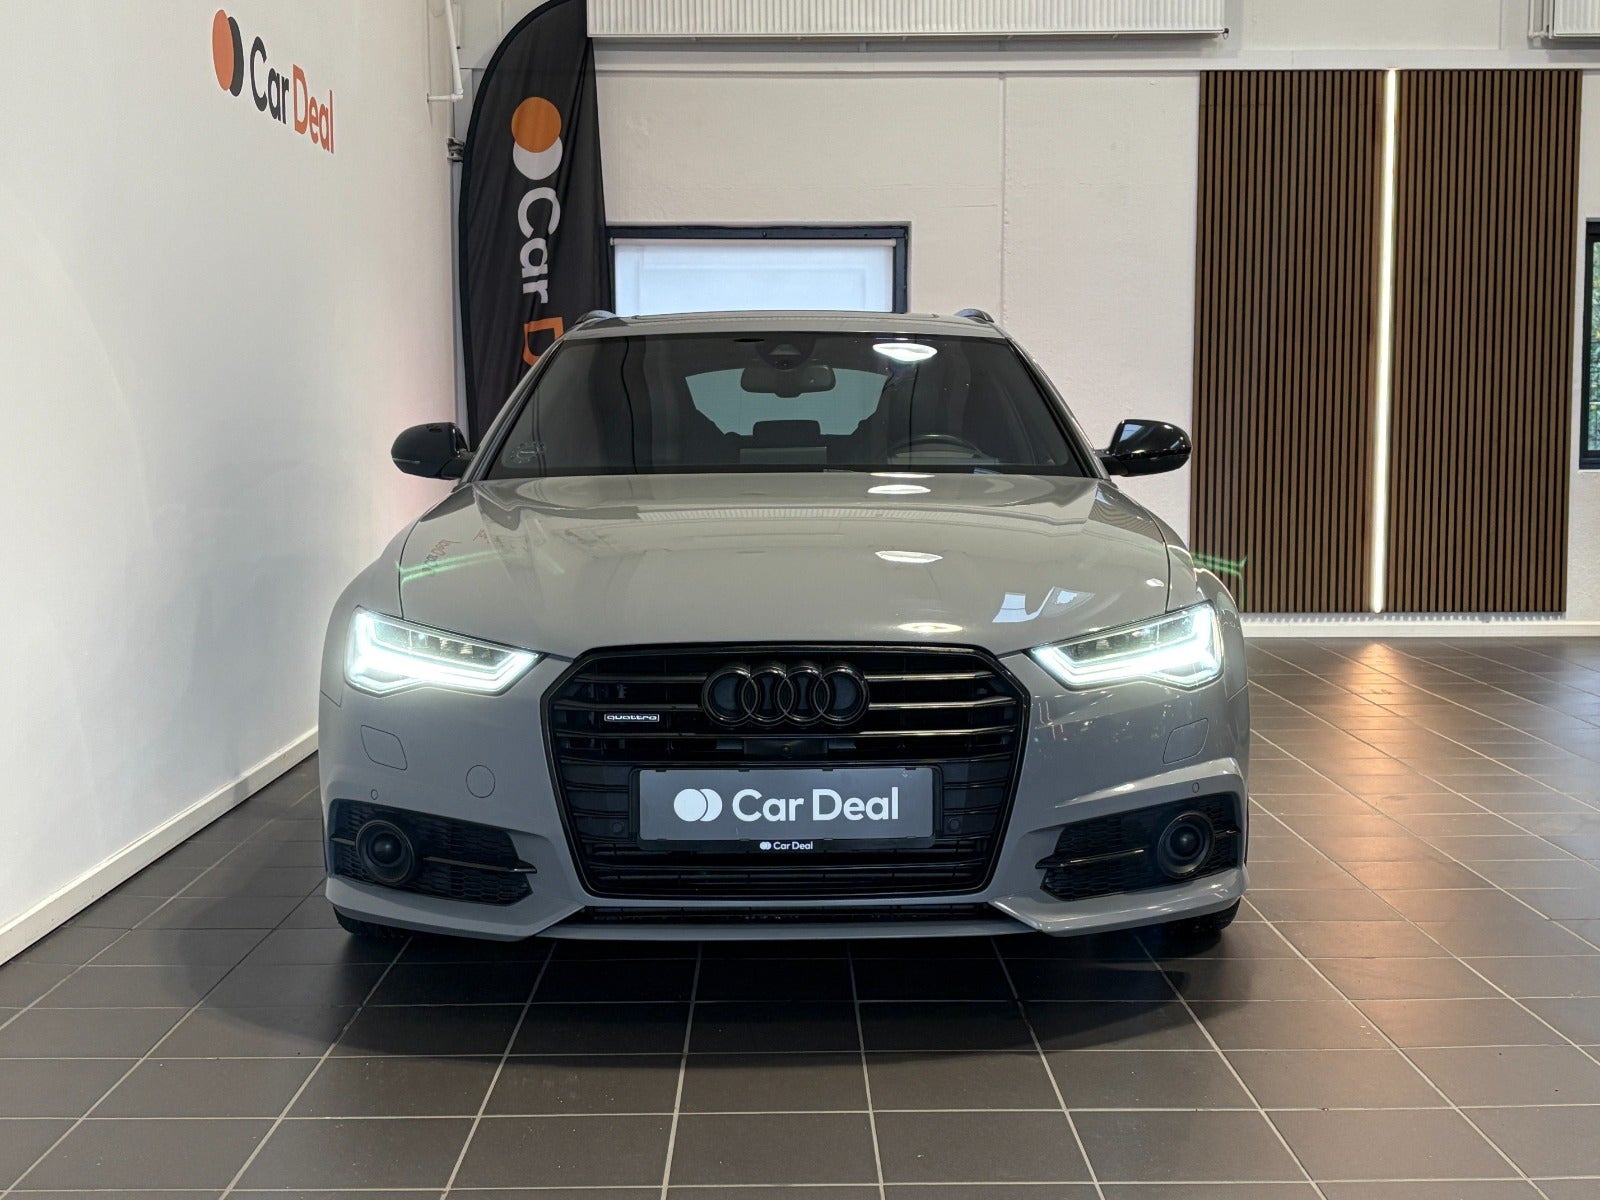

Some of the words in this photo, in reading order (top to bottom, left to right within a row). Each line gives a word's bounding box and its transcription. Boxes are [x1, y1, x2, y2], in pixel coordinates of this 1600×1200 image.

[250, 36, 289, 125] Car
[293, 64, 334, 154] Deal
[518, 187, 561, 304] Car
[732, 788, 805, 822] Car
[812, 787, 899, 821] Deal
[773, 841, 791, 850] Car
[792, 840, 813, 850] Deal
